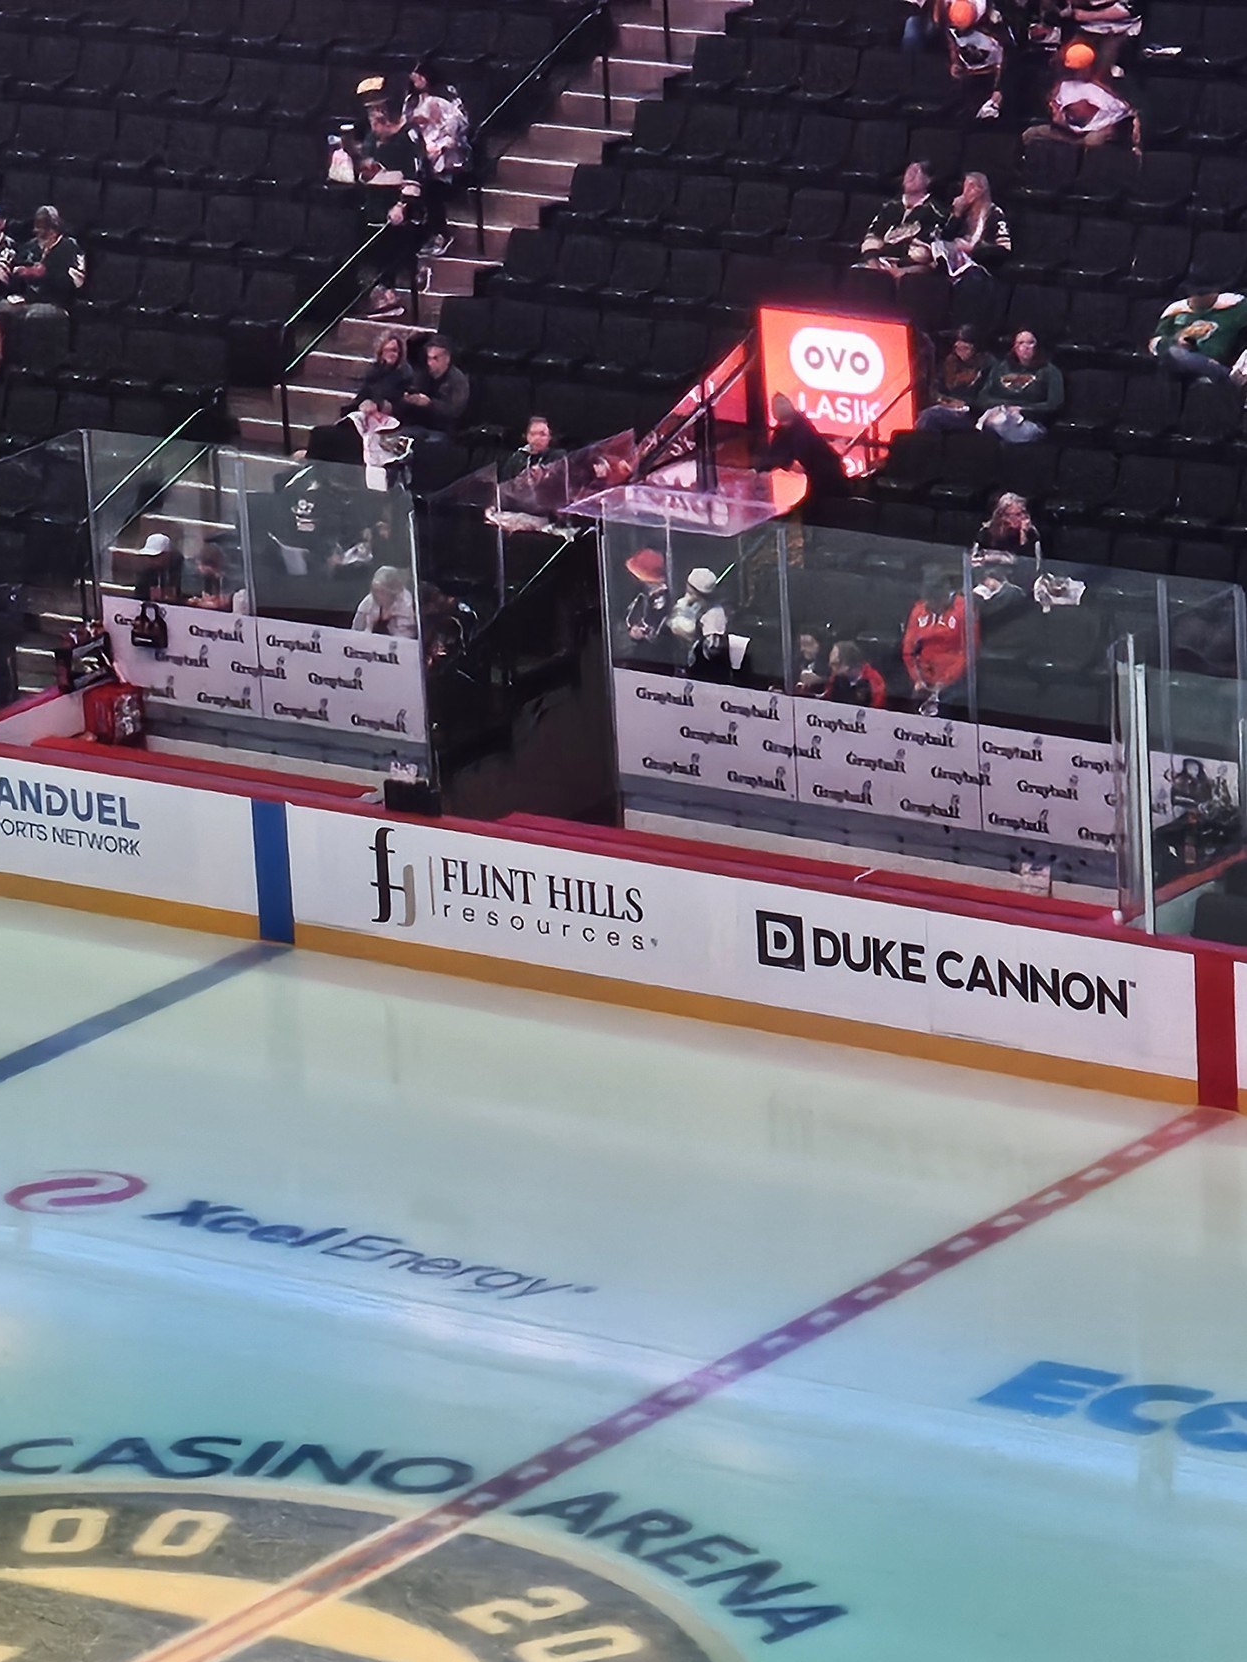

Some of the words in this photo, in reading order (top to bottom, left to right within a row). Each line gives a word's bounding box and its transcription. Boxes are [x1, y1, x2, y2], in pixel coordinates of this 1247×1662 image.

[804, 345, 870, 376] OVO
[798, 391, 881, 425] LASIK
[52, 825, 142, 857] NETWORK
[441, 856, 537, 905] FLINT
[546, 874, 644, 923] HILLS
[443, 903, 645, 951] resources
[812, 926, 927, 984] DUKE
[935, 950, 1130, 1019] CANNON
[519, 1490, 849, 1645] ARENA
